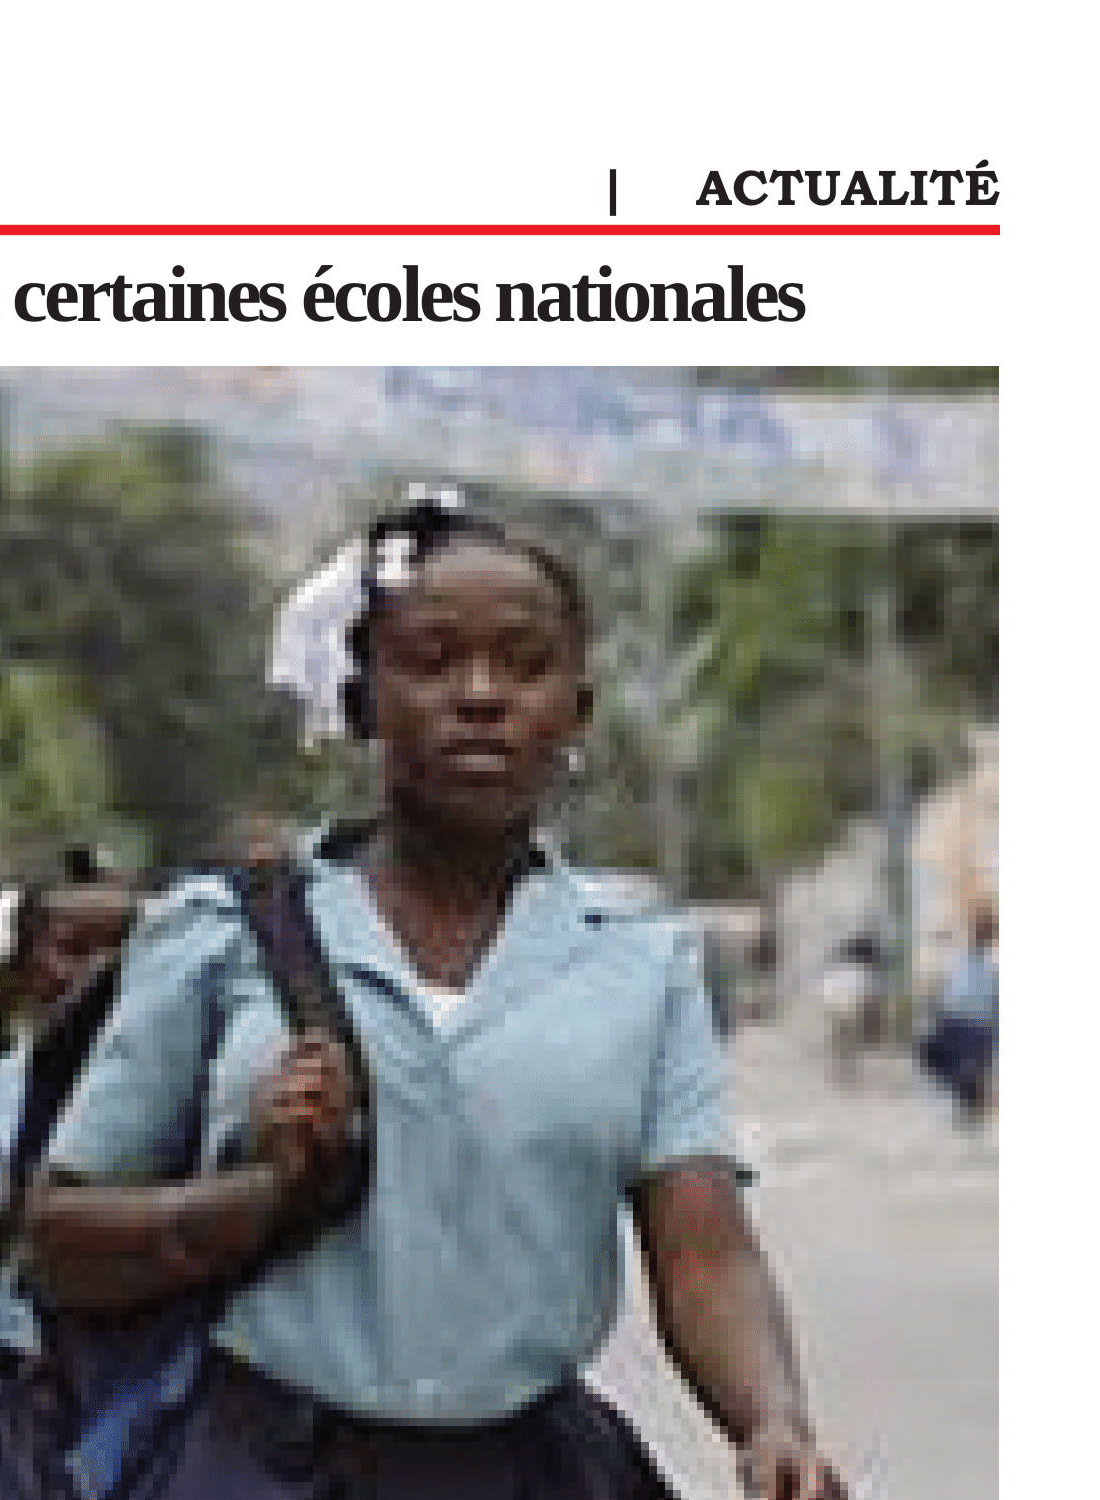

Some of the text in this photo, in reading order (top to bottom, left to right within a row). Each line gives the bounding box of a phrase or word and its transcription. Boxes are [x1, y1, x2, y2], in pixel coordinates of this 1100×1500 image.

[695, 159, 1001, 207] ACTUALITÉ
[15, 265, 286, 322] certaines
[304, 265, 480, 322] écoles
[496, 265, 805, 322] nationales
